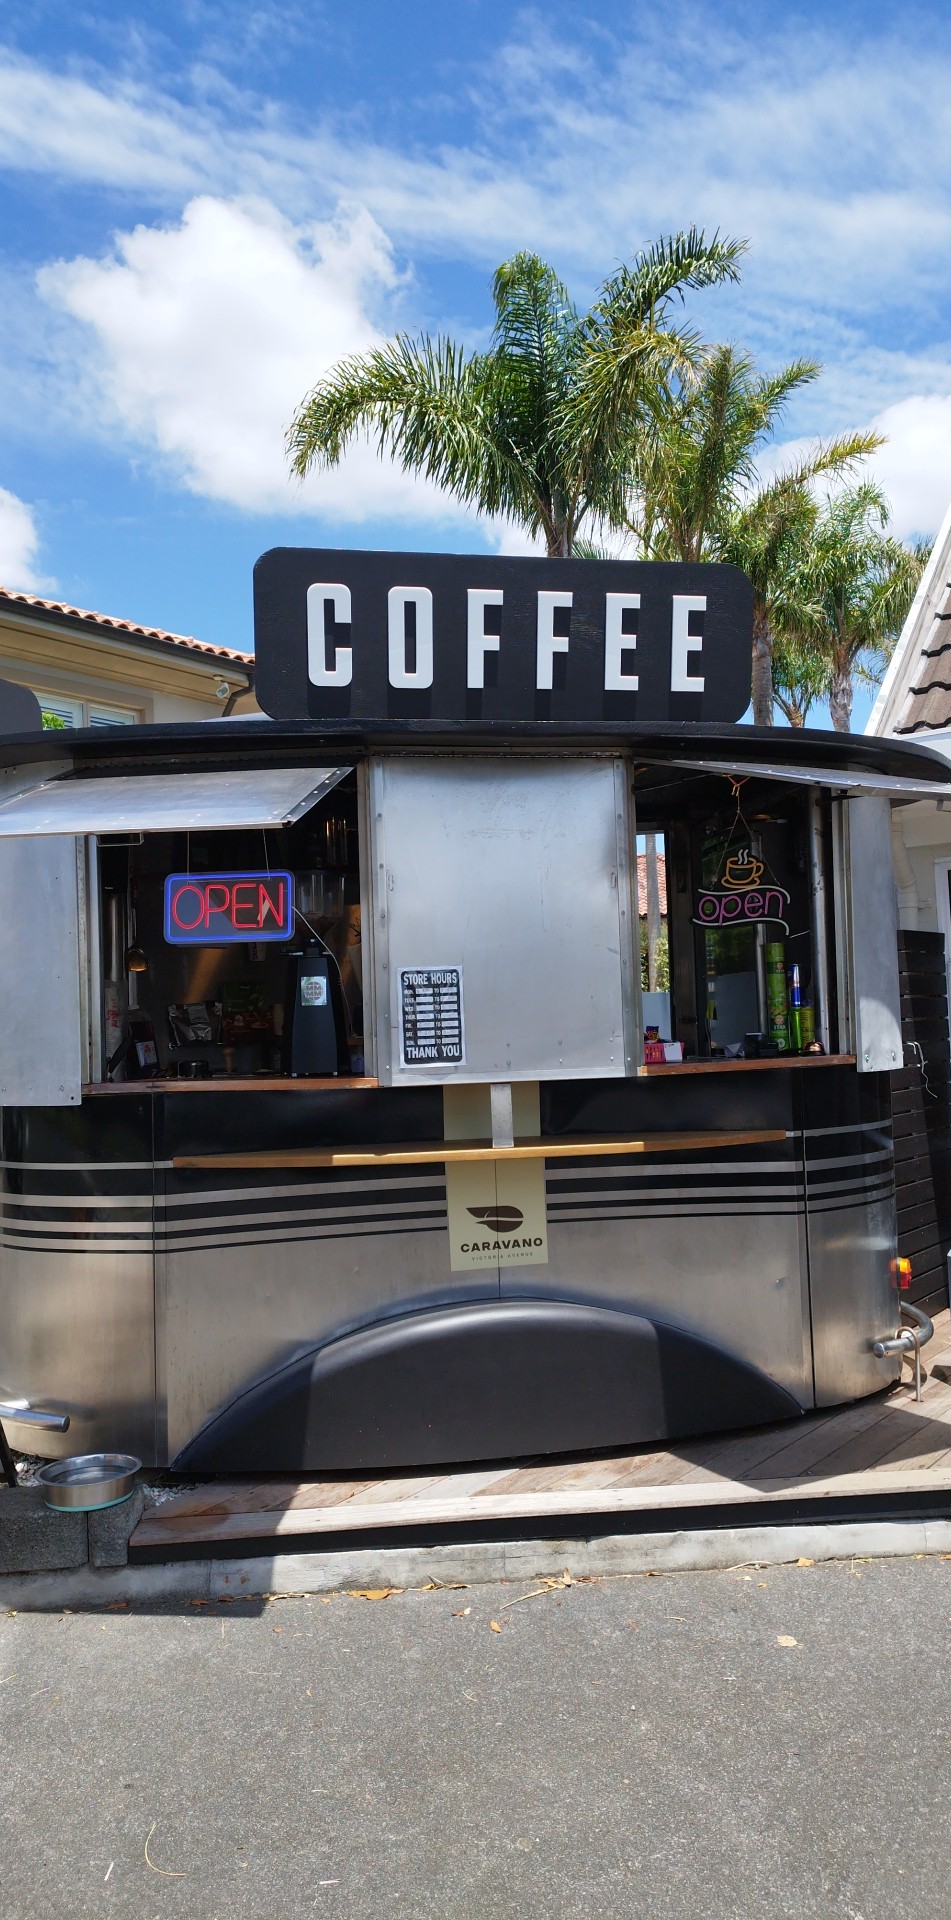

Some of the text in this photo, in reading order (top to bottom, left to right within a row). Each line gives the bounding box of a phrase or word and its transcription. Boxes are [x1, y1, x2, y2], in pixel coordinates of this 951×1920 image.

[306, 583, 707, 692] COFFEE
[171, 882, 284, 930] OPEN
[698, 890, 784, 927] open
[404, 972, 457, 985] STORE HOURS
[407, 1045, 460, 1058] THANK YOU
[460, 1238, 543, 1253] CARAVANO
